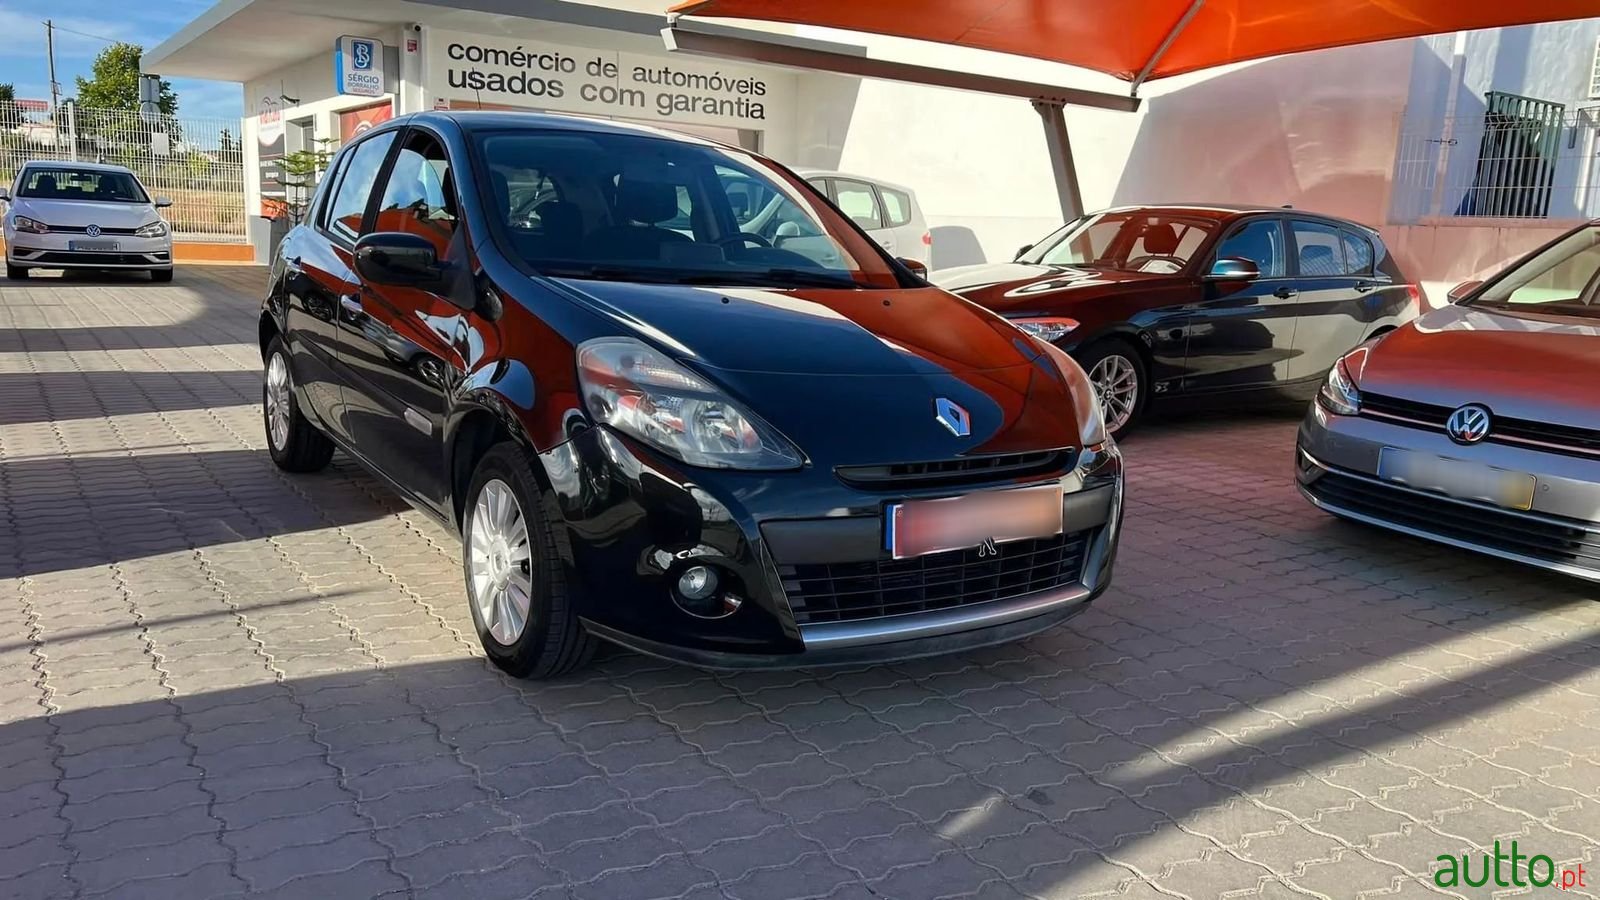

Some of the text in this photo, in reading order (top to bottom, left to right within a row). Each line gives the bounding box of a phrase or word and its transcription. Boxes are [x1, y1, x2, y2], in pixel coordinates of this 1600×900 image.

[347, 72, 379, 84] SÉRGIO
[447, 43, 576, 73] comércio
[586, 57, 619, 78] de
[632, 66, 766, 96] automóveis
[447, 69, 766, 120] usados com garantia
